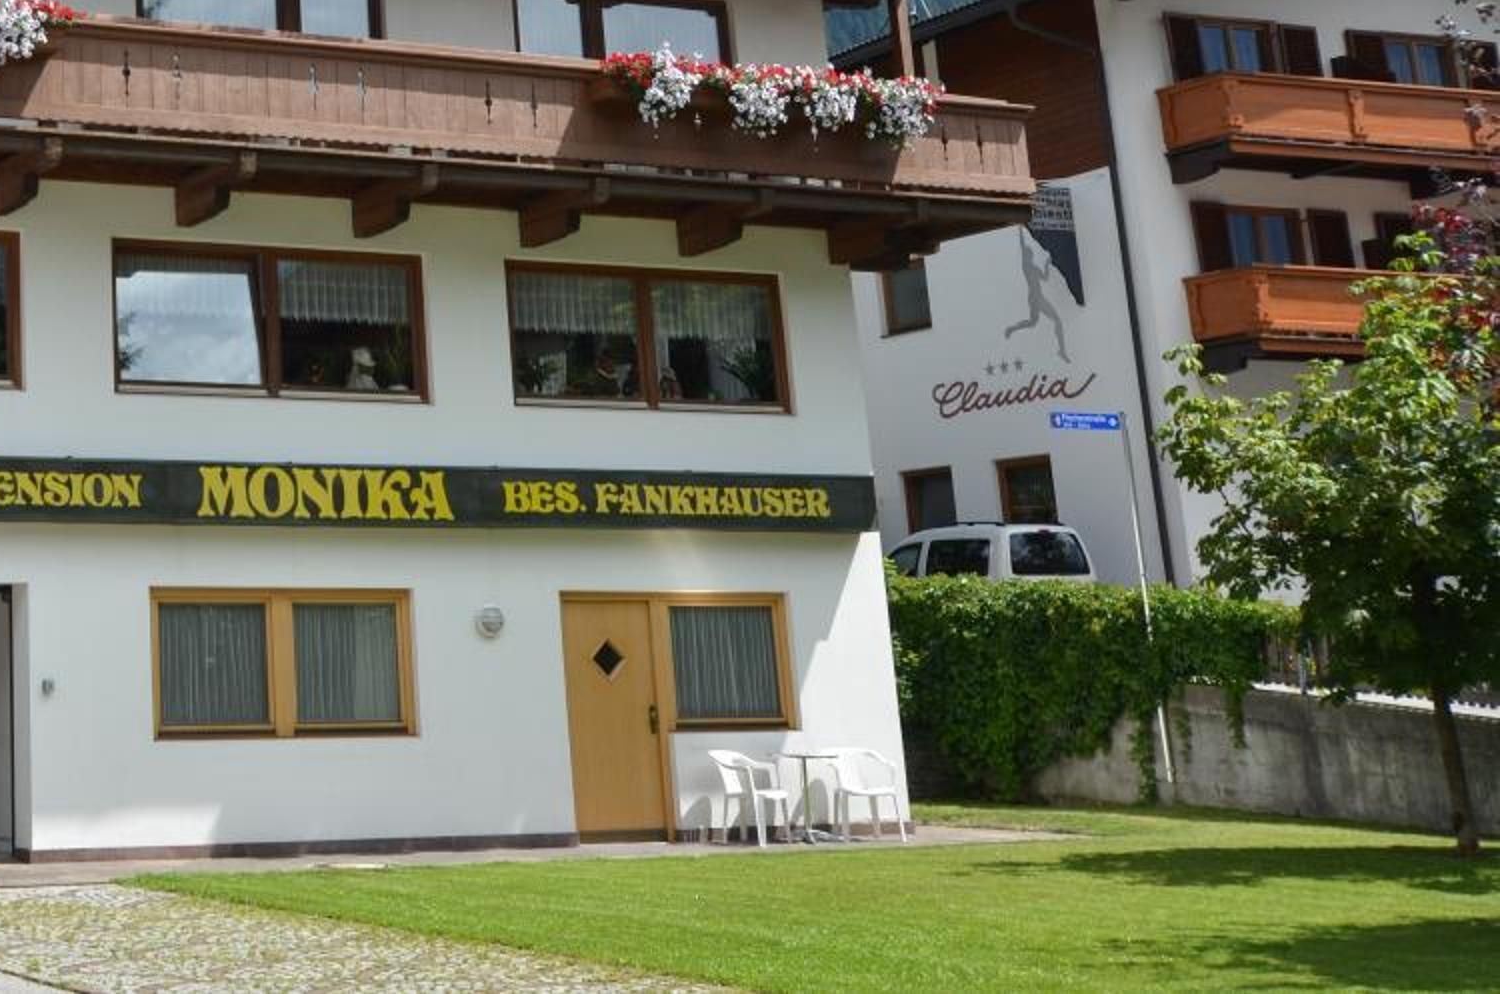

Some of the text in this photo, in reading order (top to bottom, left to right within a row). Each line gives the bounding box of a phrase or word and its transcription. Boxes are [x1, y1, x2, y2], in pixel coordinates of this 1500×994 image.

[932, 373, 1096, 419] Claudia
[197, 465, 454, 522] MONIKA
[503, 480, 587, 514] BES.
[595, 482, 831, 517] FANKHAUSER
